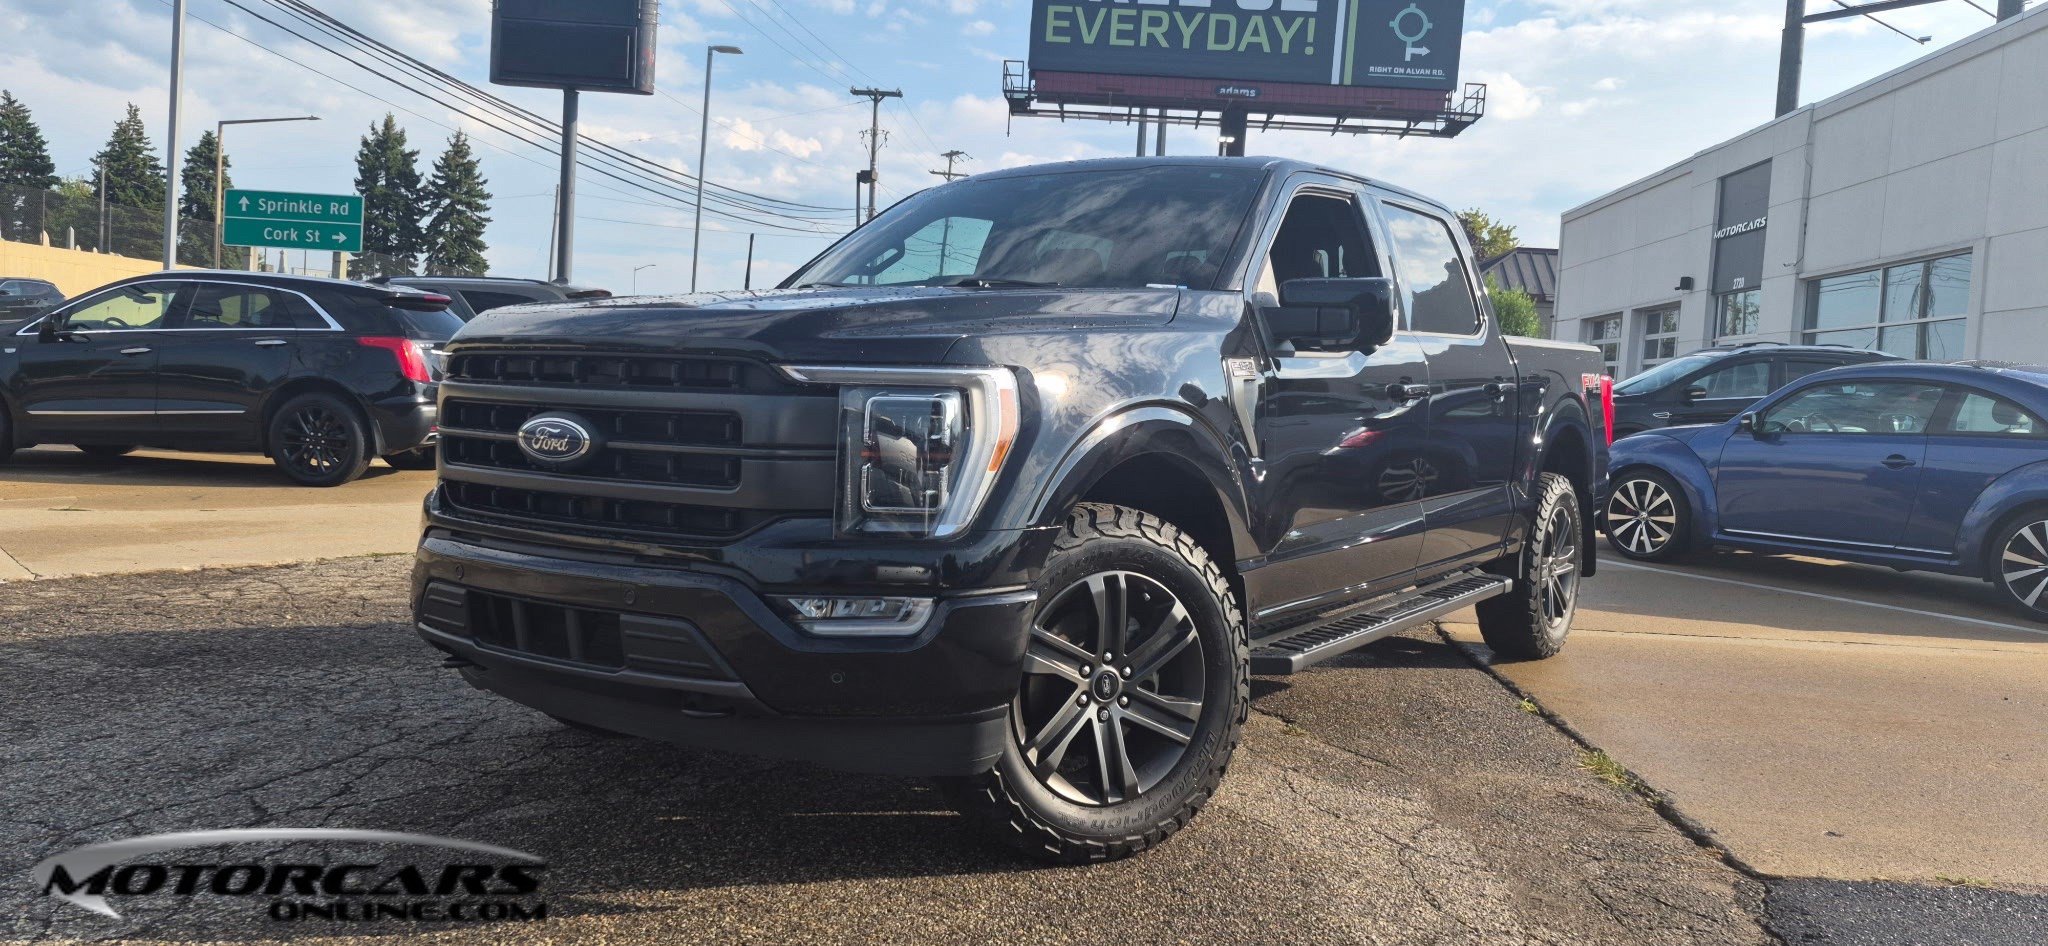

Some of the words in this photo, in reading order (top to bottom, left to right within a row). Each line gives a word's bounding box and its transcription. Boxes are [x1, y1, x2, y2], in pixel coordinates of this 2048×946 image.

[1044, 5, 1316, 56] EVERYDAY!
[1369, 65, 1393, 74] RIGHT
[1406, 67, 1431, 75] ALVAN
[1219, 86, 1256, 97] adams
[258, 198, 322, 214] Sprinkle
[330, 202, 349, 216] Rd
[263, 227, 298, 241] Cork
[305, 229, 320, 243] St
[1713, 216, 1767, 239] MOTORCARS
[531, 426, 569, 452] Ford
